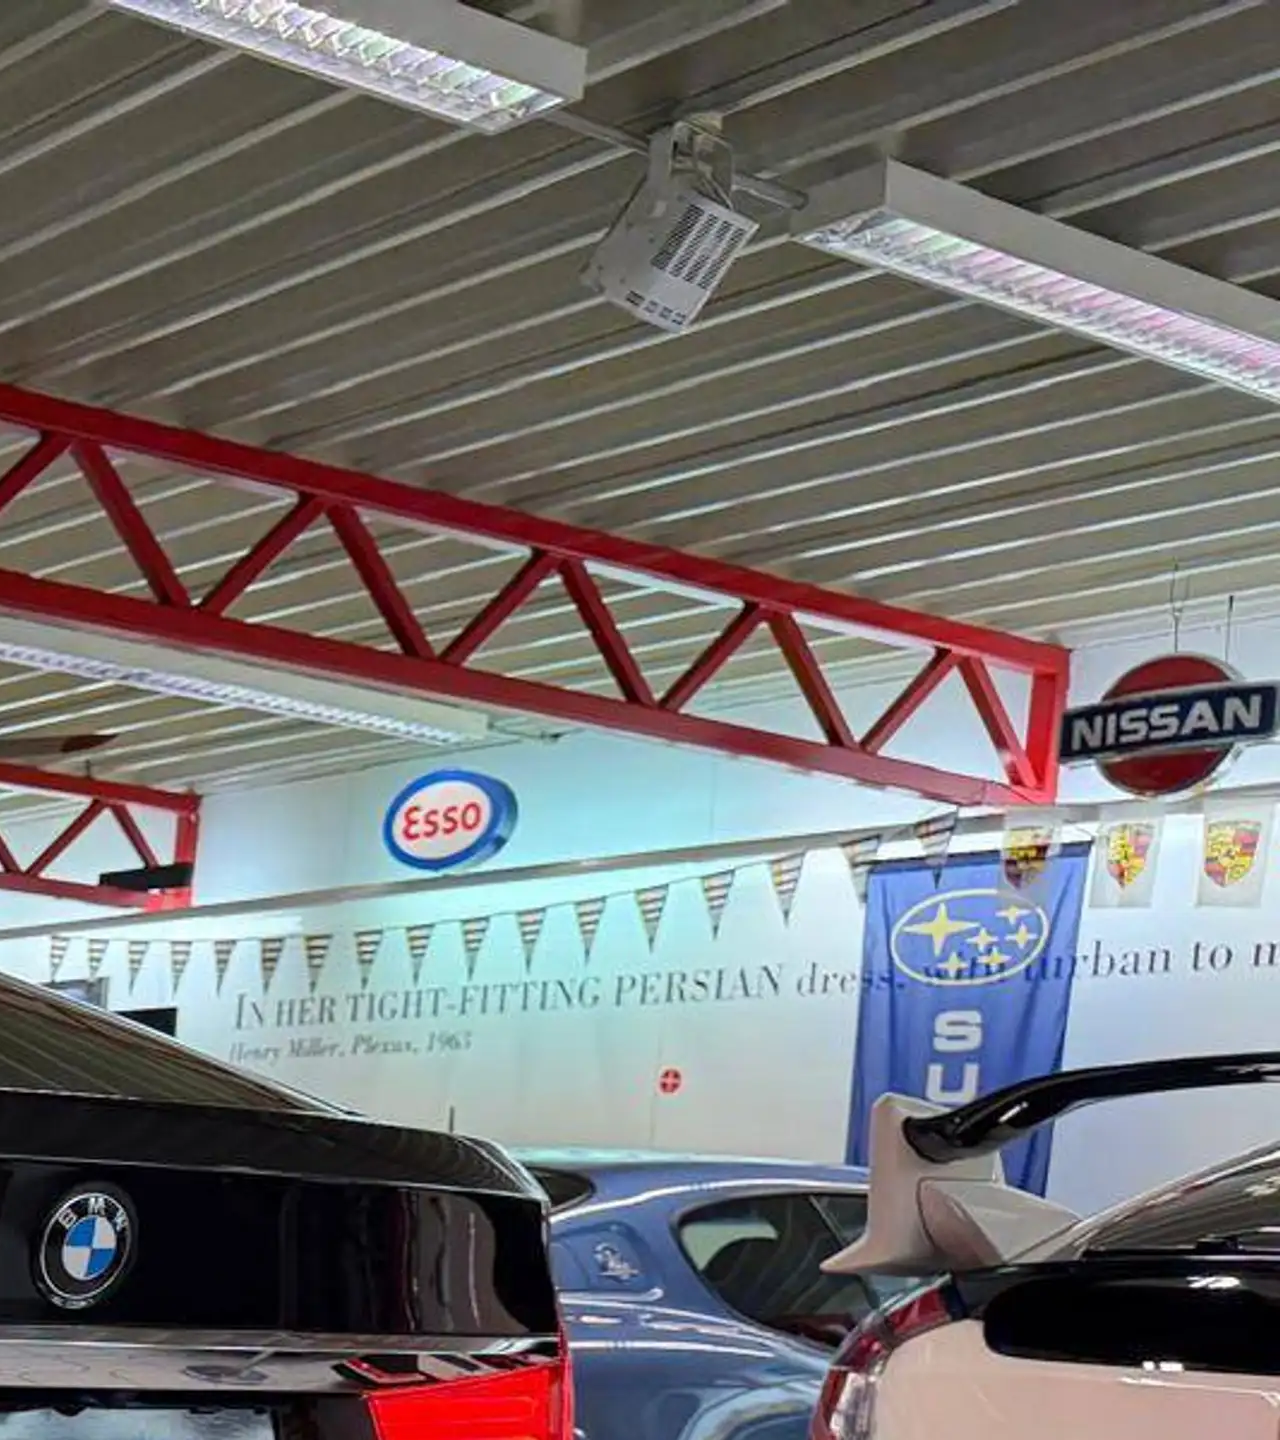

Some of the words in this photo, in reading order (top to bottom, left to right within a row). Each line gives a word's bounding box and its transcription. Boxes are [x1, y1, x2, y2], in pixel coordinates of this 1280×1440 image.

[1070, 693, 1262, 751] NISSAN
[274, 993, 338, 1028] HER
[344, 974, 602, 1023] TIGHT-FITTING
[613, 962, 785, 1007] PERSIAN
[1191, 940, 1234, 973] to
[228, 1040, 281, 1068] Henry
[926, 1009, 982, 1106] SU
[58, 1196, 129, 1232] BMW
